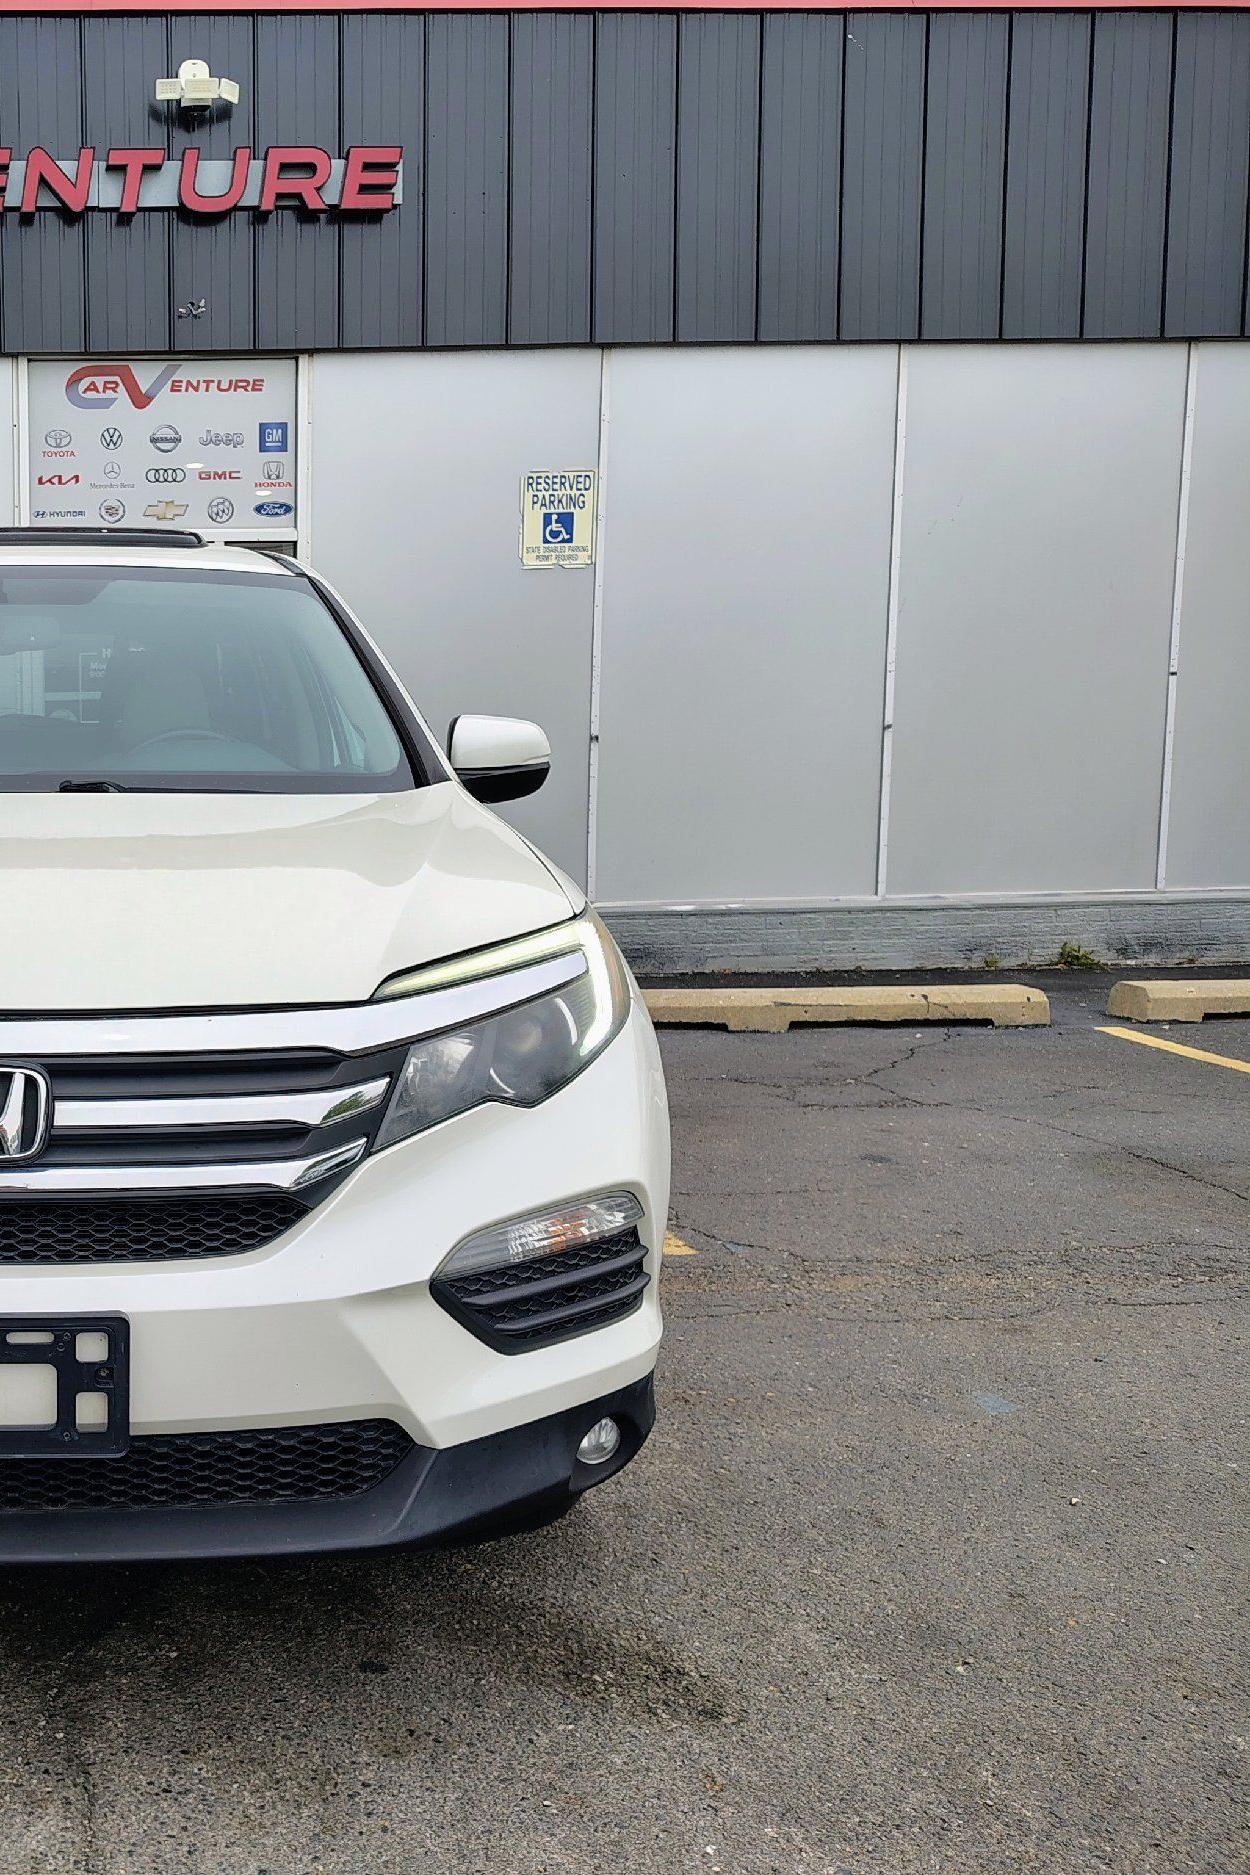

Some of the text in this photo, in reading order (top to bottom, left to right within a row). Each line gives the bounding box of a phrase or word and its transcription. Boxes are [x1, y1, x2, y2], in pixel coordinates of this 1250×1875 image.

[199, 430, 244, 448] Jeep
[265, 429, 282, 442] GM
[42, 450, 76, 458] TOYOTA
[38, 474, 80, 486] KIA
[198, 470, 242, 480] GMC
[527, 475, 591, 492] RESERVED
[532, 493, 586, 510] PARKING
[261, 503, 287, 515] Ford
